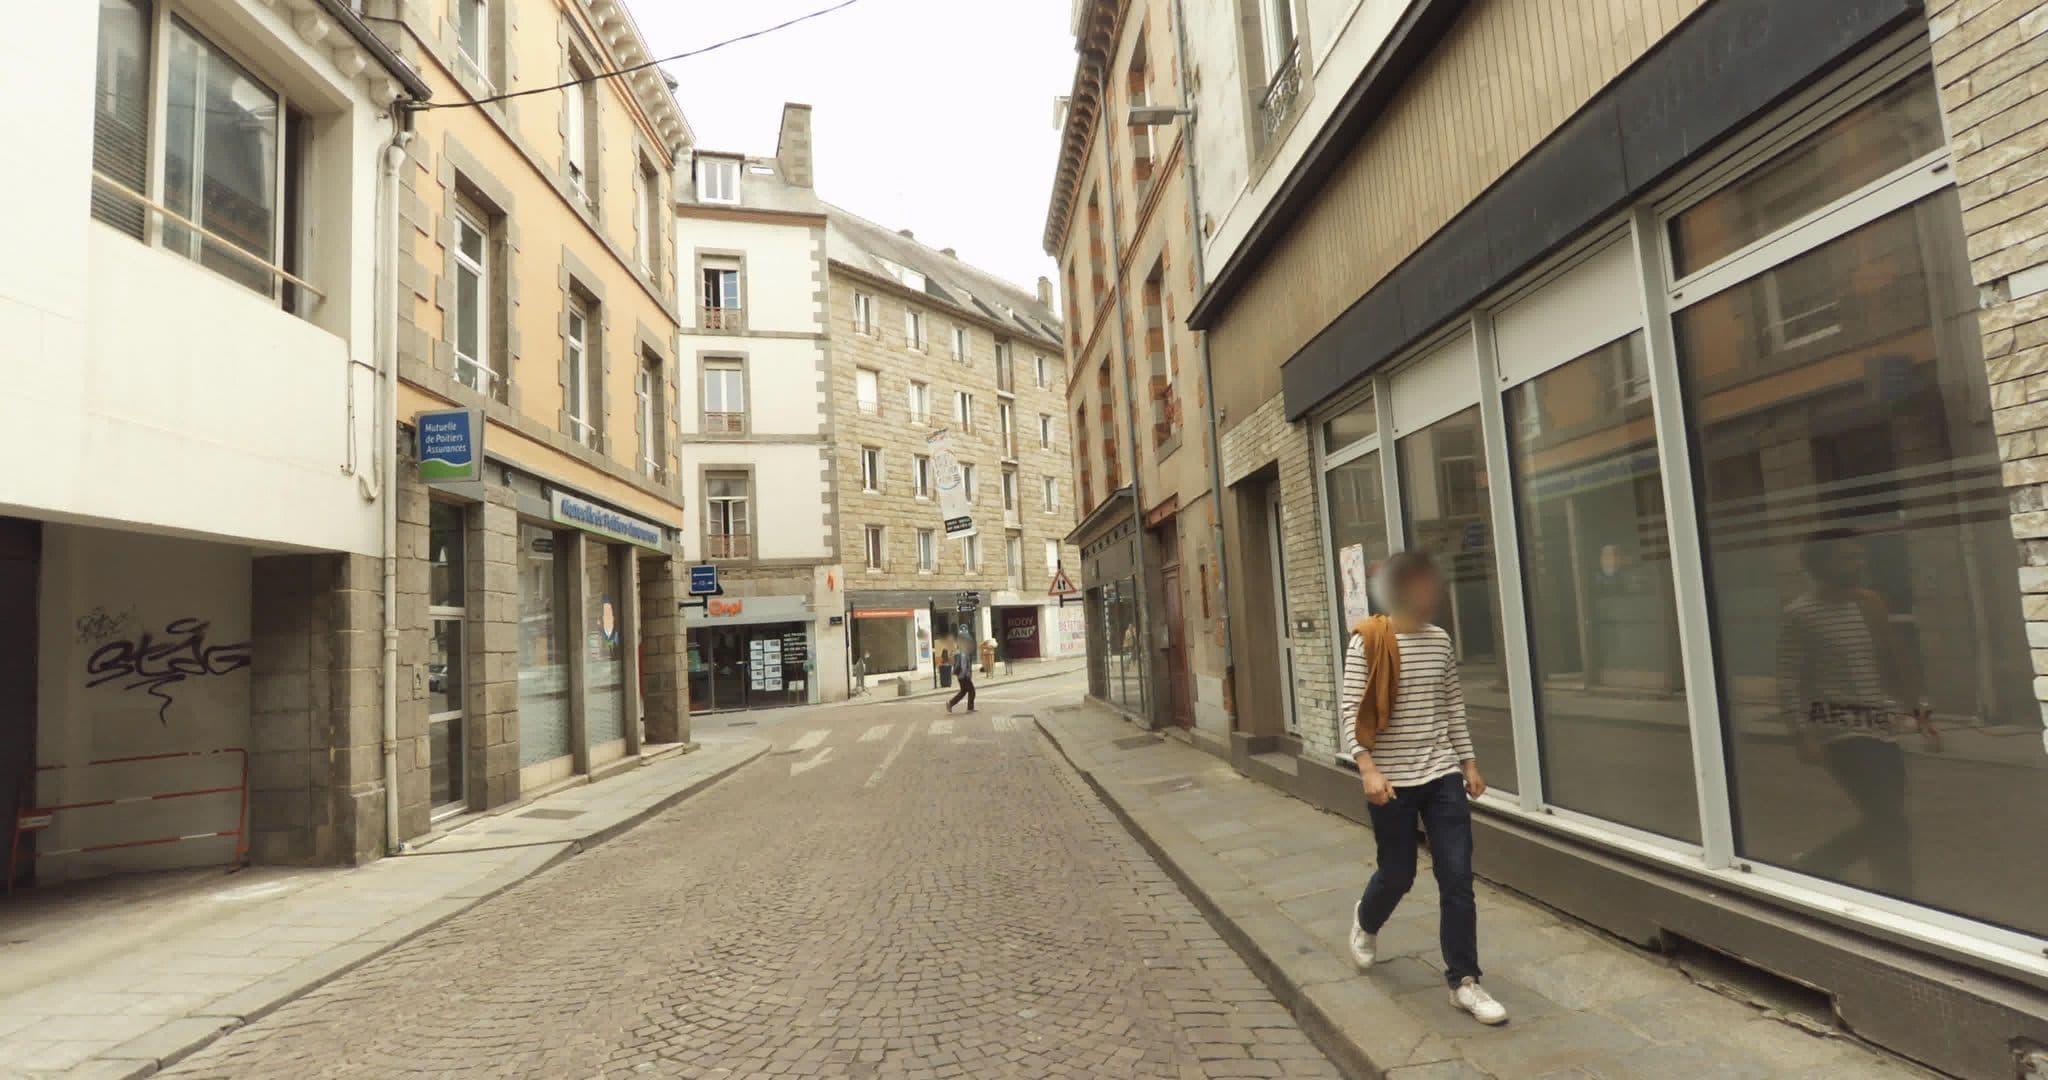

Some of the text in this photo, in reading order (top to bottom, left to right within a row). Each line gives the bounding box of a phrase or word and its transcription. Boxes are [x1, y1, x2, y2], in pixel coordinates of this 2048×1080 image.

[425, 422, 457, 431] Mutuelle
[425, 433, 464, 444] de Poitiers
[426, 445, 467, 454] Assurances
[709, 599, 743, 617] Orpi
